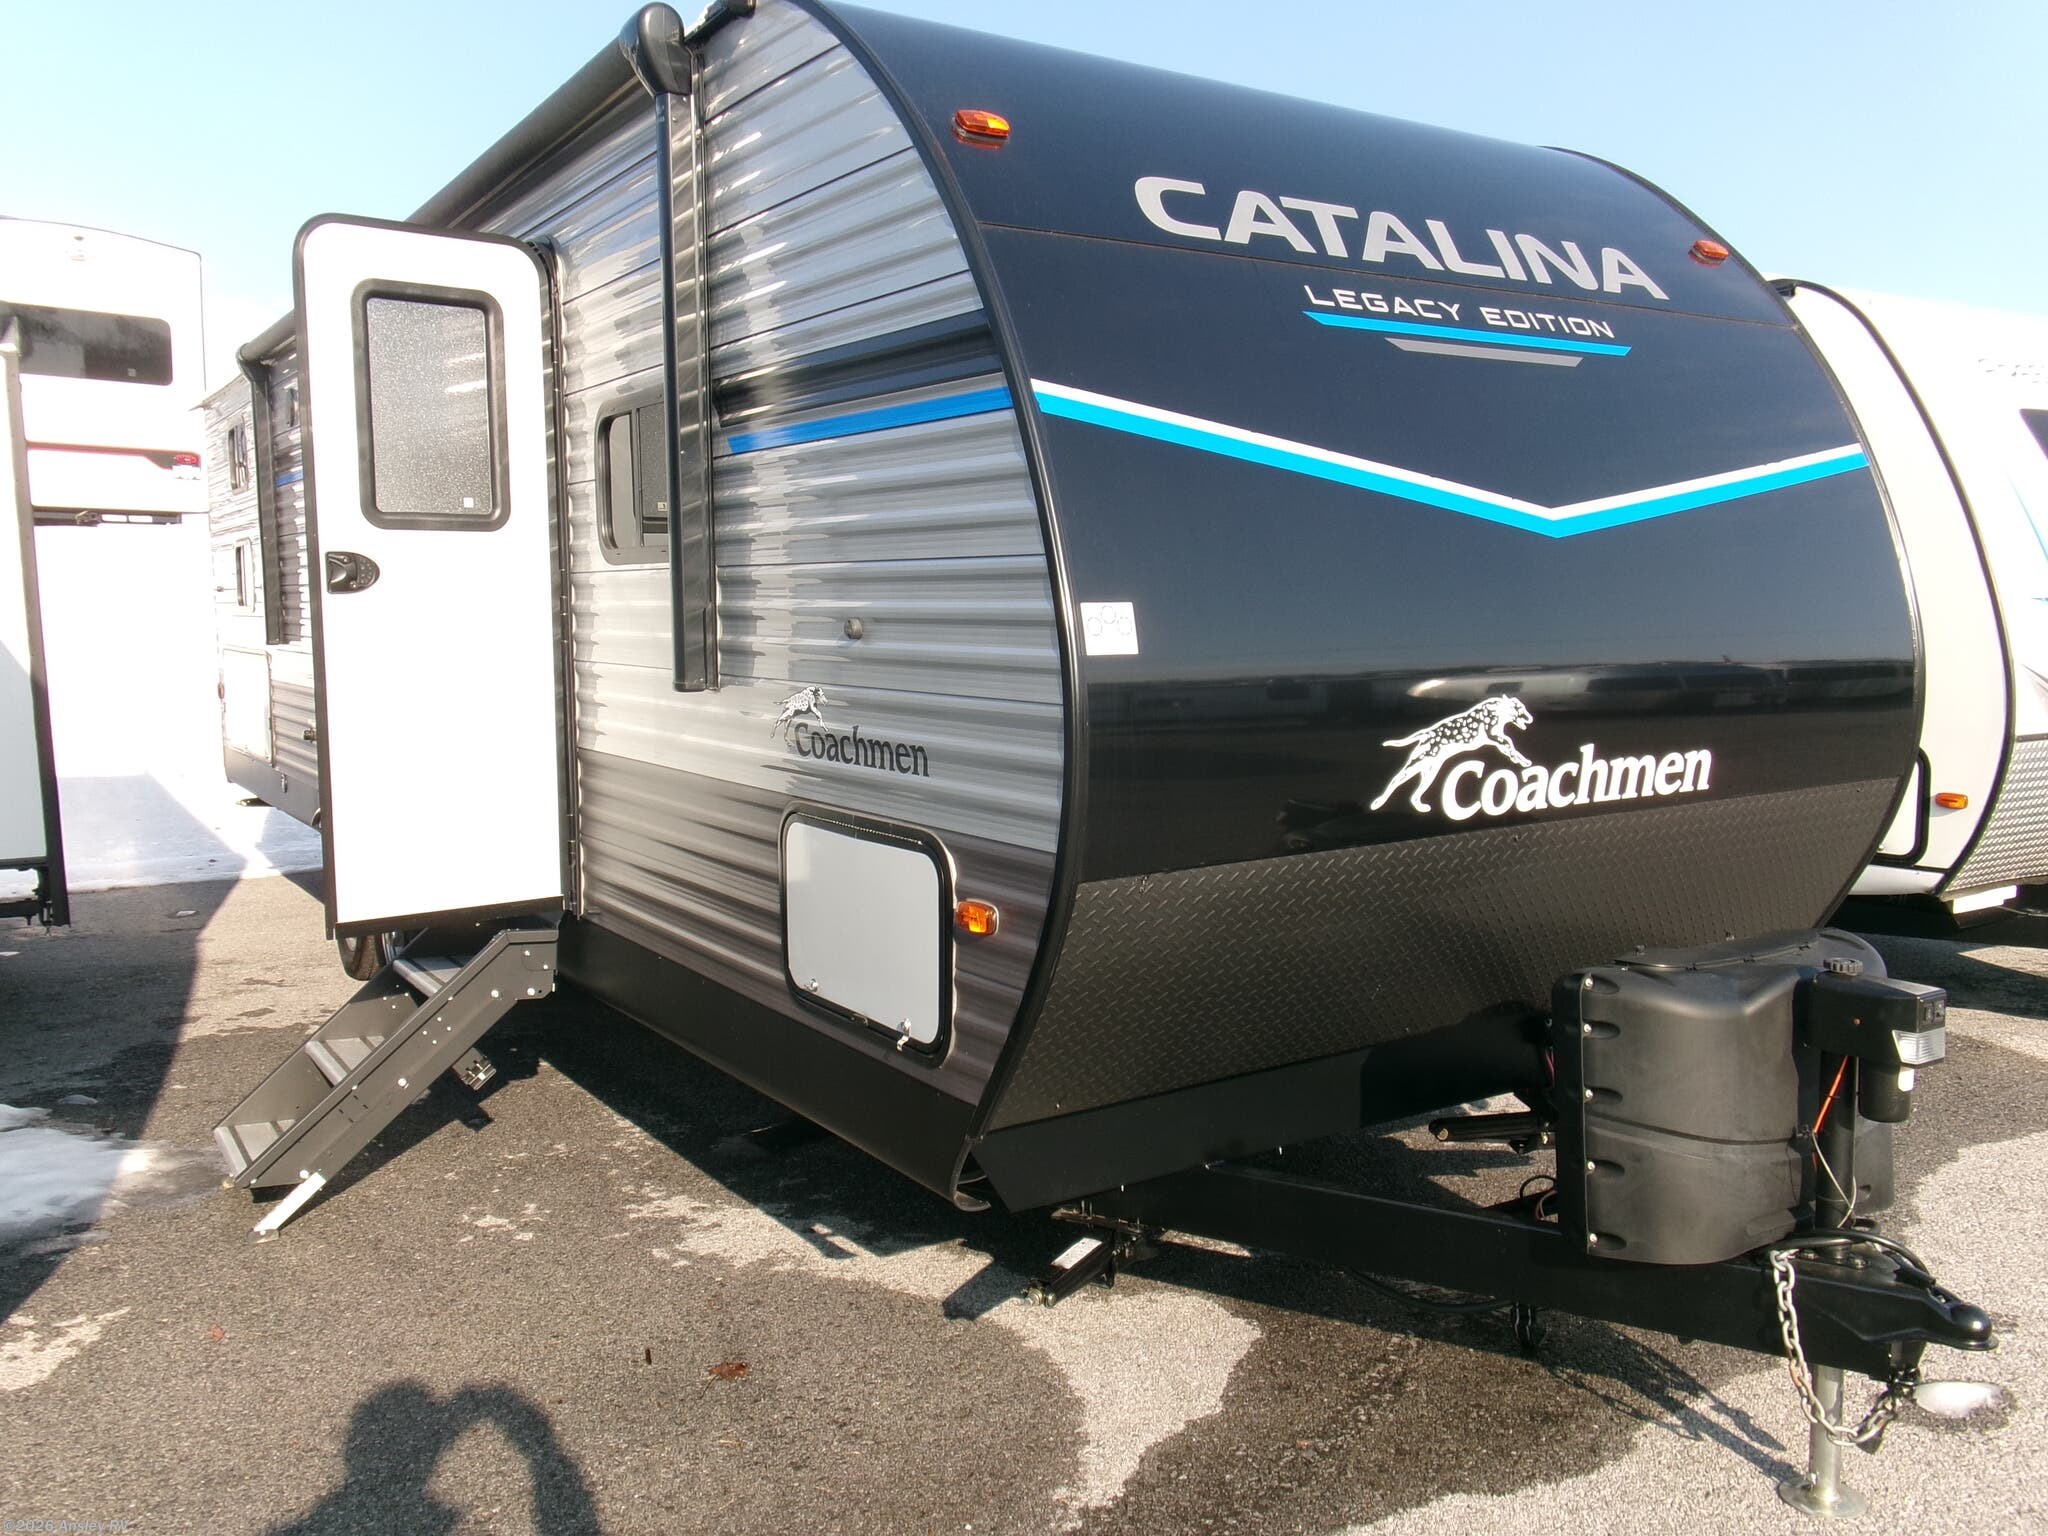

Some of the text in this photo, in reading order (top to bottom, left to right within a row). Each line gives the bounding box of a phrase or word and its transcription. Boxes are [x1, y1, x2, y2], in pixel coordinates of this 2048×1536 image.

[1135, 176, 1669, 300] CATALINA
[1305, 285, 1615, 339] LEGACY EDITION
[794, 722, 930, 778] Coachmen
[1442, 743, 1713, 822] Coachmen
